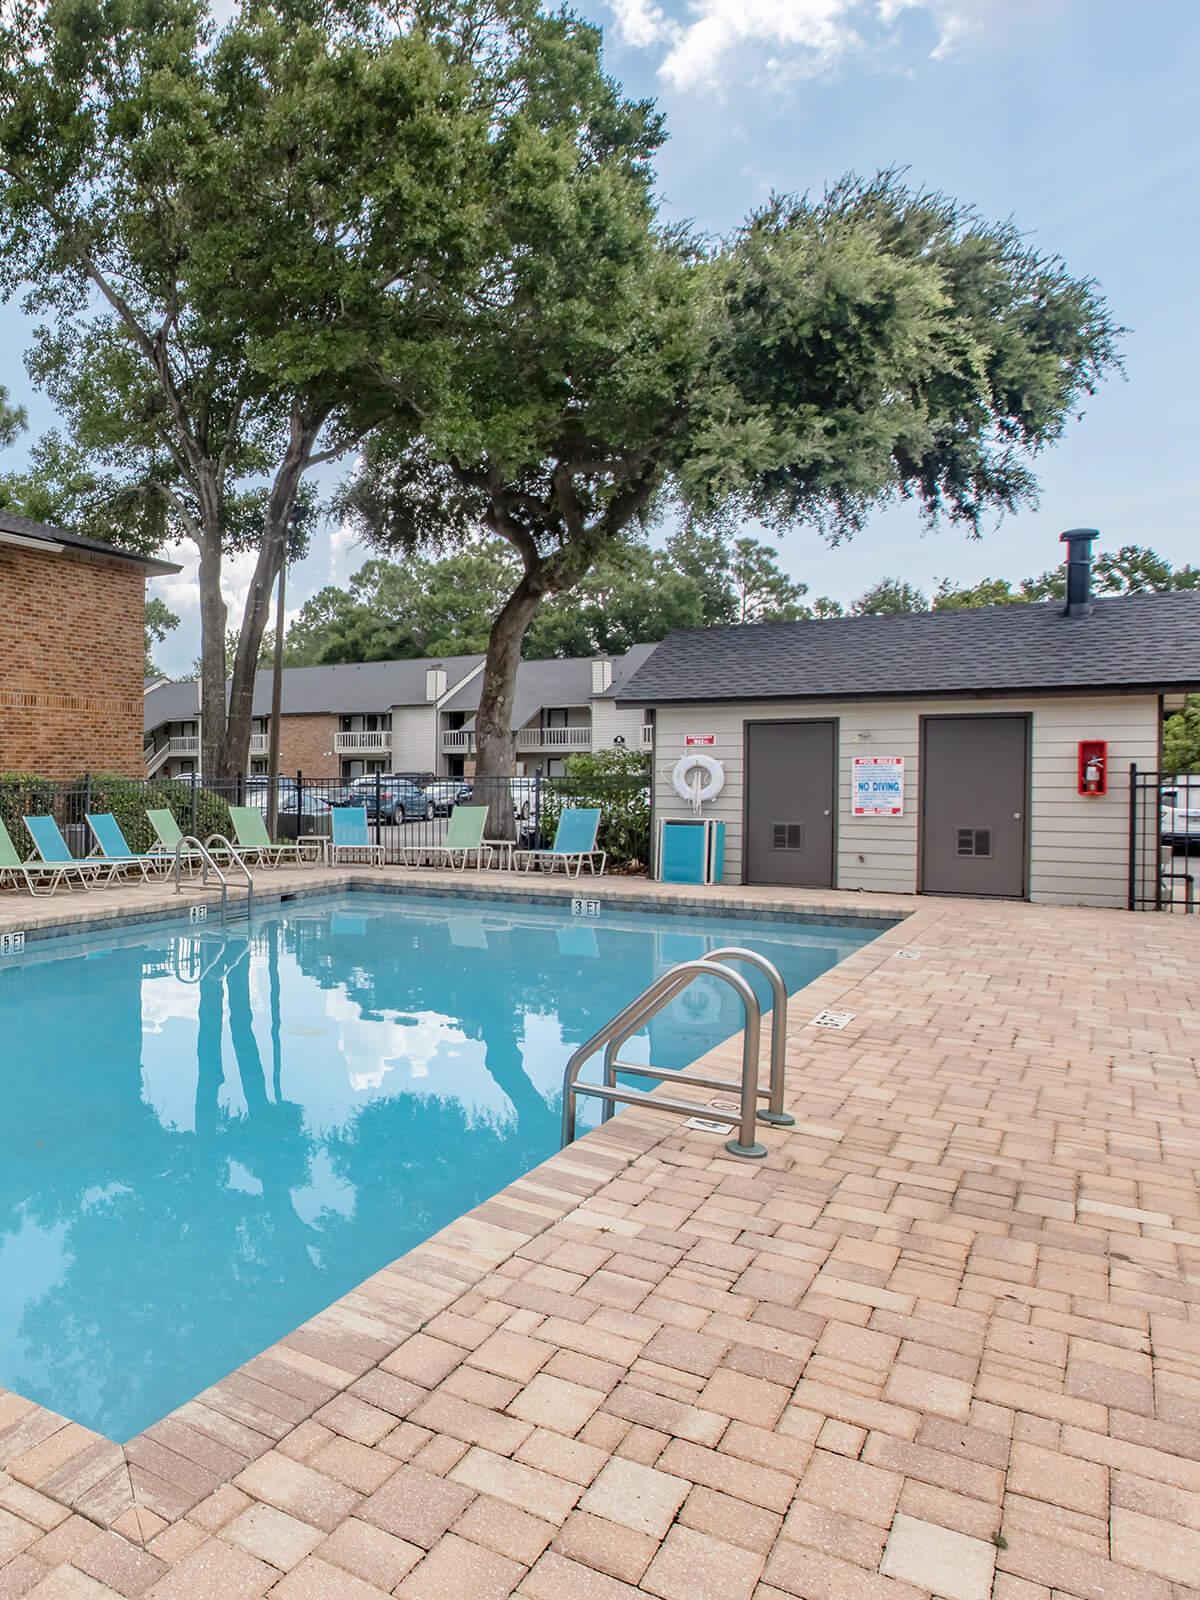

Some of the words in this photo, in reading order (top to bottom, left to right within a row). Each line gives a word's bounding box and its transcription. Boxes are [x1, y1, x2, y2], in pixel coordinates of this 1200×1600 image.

[858, 782, 870, 791] NO
[872, 782, 900, 791] DIVING
[13, 933, 24, 945] FT
